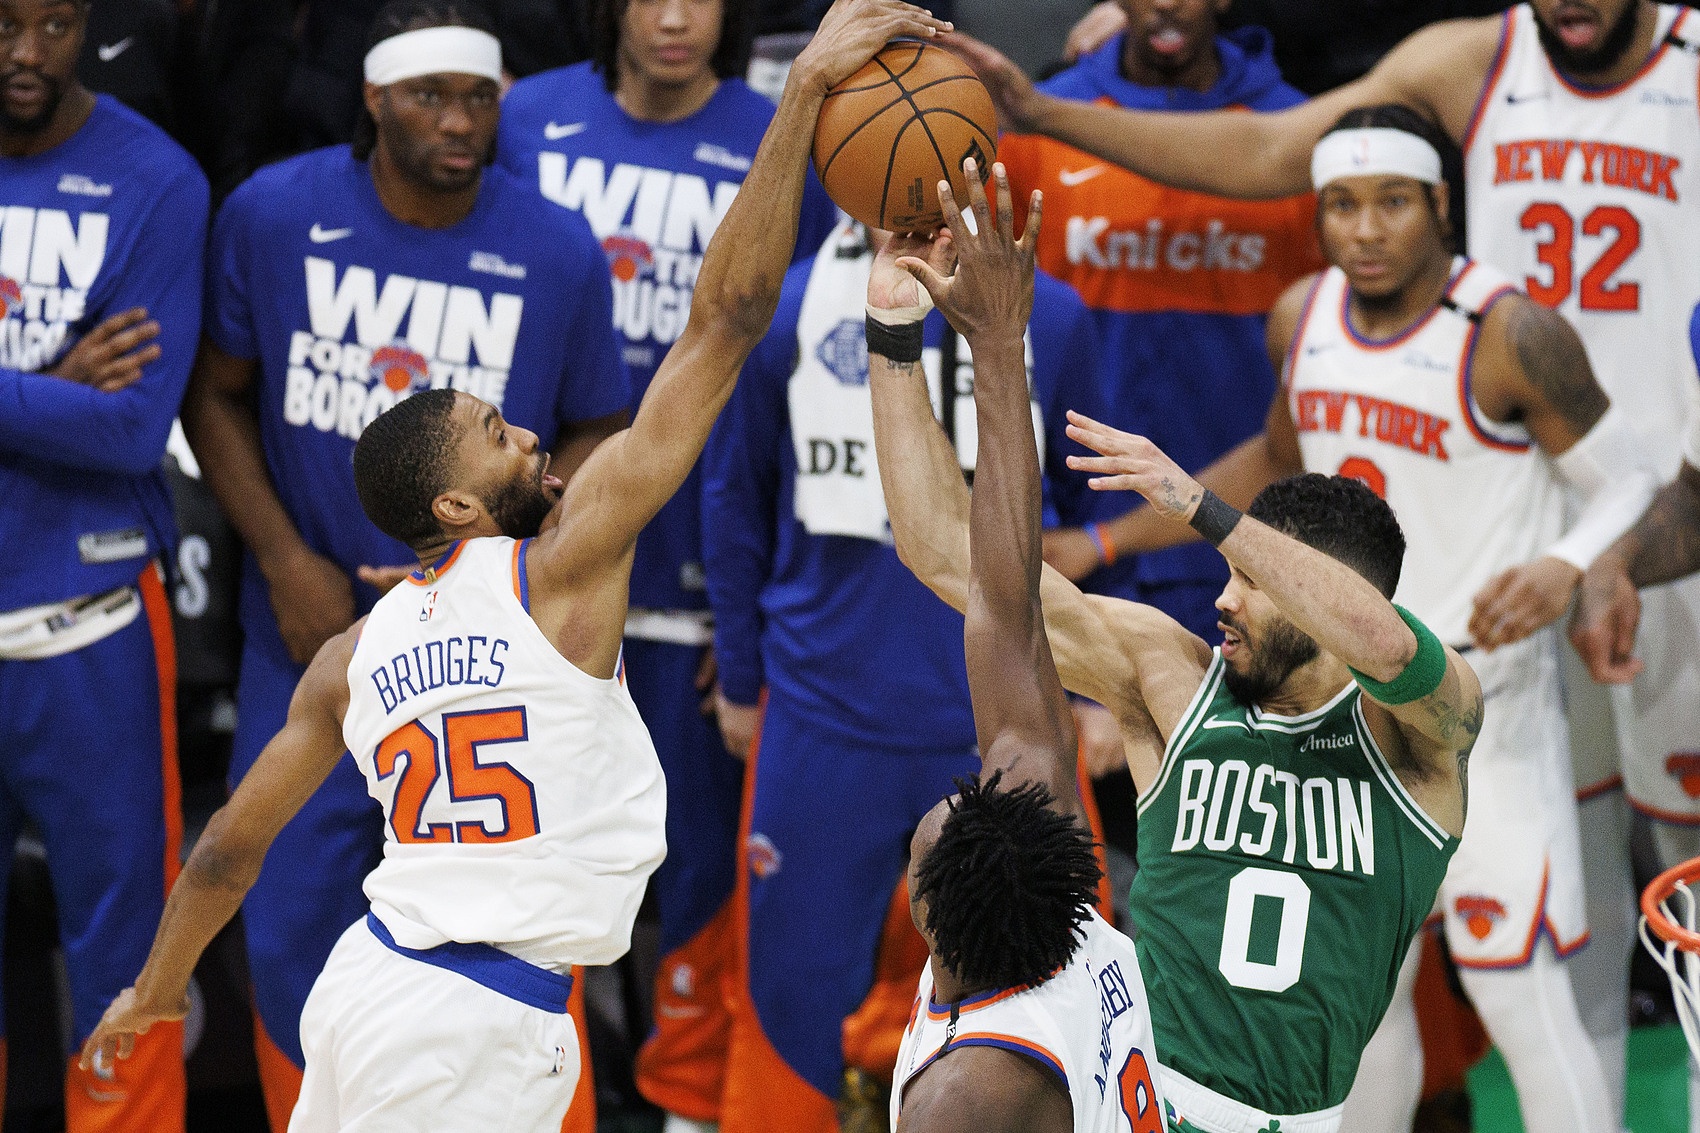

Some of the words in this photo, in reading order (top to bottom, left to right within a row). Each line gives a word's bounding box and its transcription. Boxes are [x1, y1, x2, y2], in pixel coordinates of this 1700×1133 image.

[1493, 139, 1574, 186] NEW
[1579, 139, 1681, 203] YORK
[0, 205, 110, 290] IN
[1065, 215, 1266, 271] Knicks
[1519, 200, 1641, 313] 32
[304, 255, 525, 371] WIN
[288, 330, 372, 384] FOR
[429, 360, 510, 412] THE
[1297, 389, 1349, 433] EW
[1355, 391, 1452, 462] YORK
[371, 635, 509, 715] BRIDGES
[373, 705, 541, 843] 25
[1300, 733, 1354, 753] Amica
[1171, 759, 1374, 875] BOSTON
[1218, 867, 1311, 993] 0
[946, 1023, 956, 1038] 12
